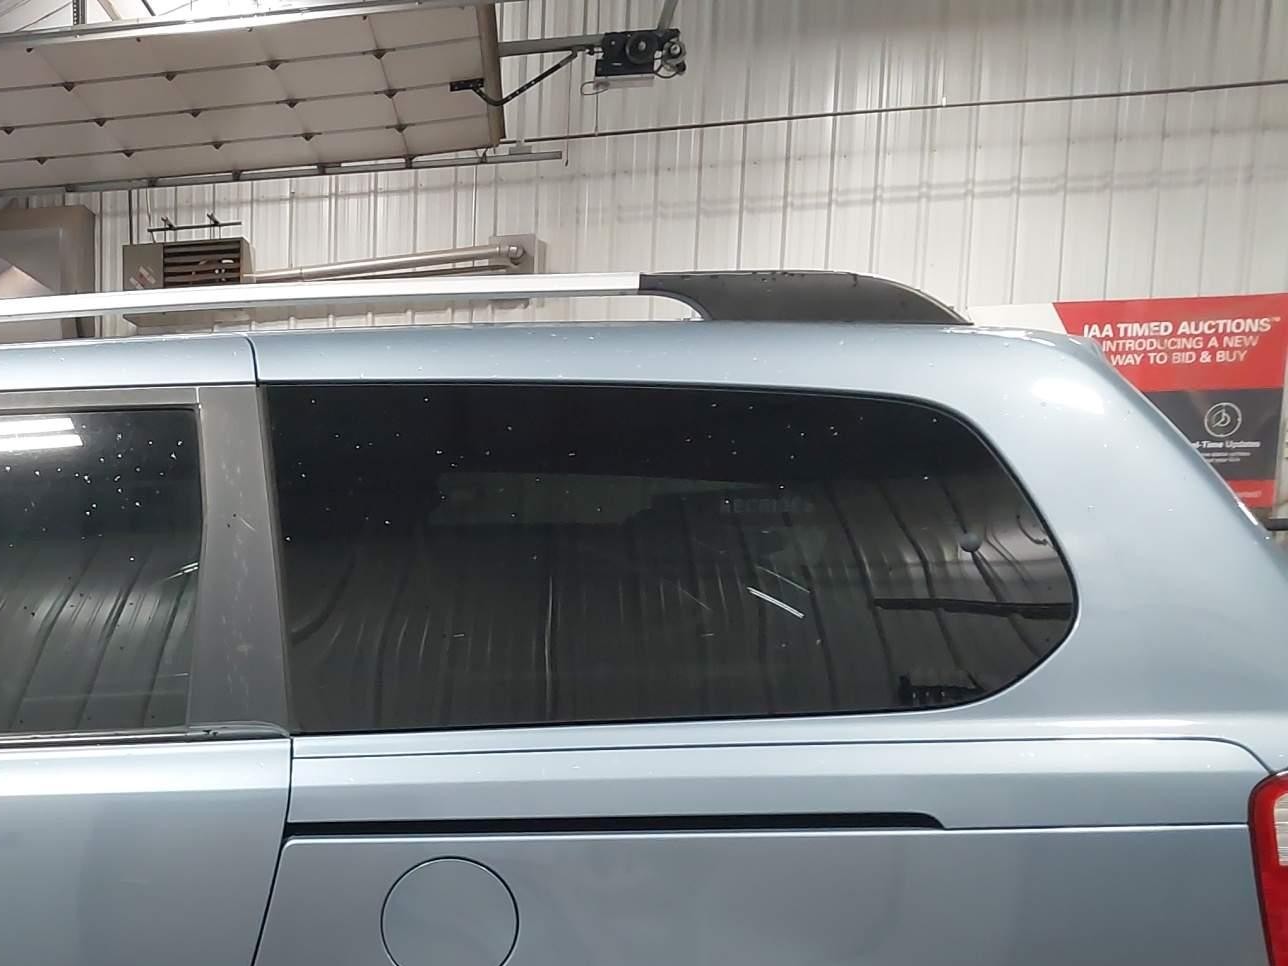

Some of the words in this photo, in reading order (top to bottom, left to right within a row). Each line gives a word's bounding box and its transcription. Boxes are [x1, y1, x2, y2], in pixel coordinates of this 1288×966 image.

[1083, 323, 1114, 338] IAA
[1116, 321, 1173, 337] TIMED
[1102, 334, 1203, 352] INTRODUCING
[1207, 335, 1219, 348] A
[1223, 335, 1260, 348] NEW
[1110, 352, 1144, 366] WAY
[1147, 351, 1168, 365] TO
[1172, 351, 1196, 364] BID
[1199, 350, 1212, 363] &
[1215, 349, 1248, 362] BUY
